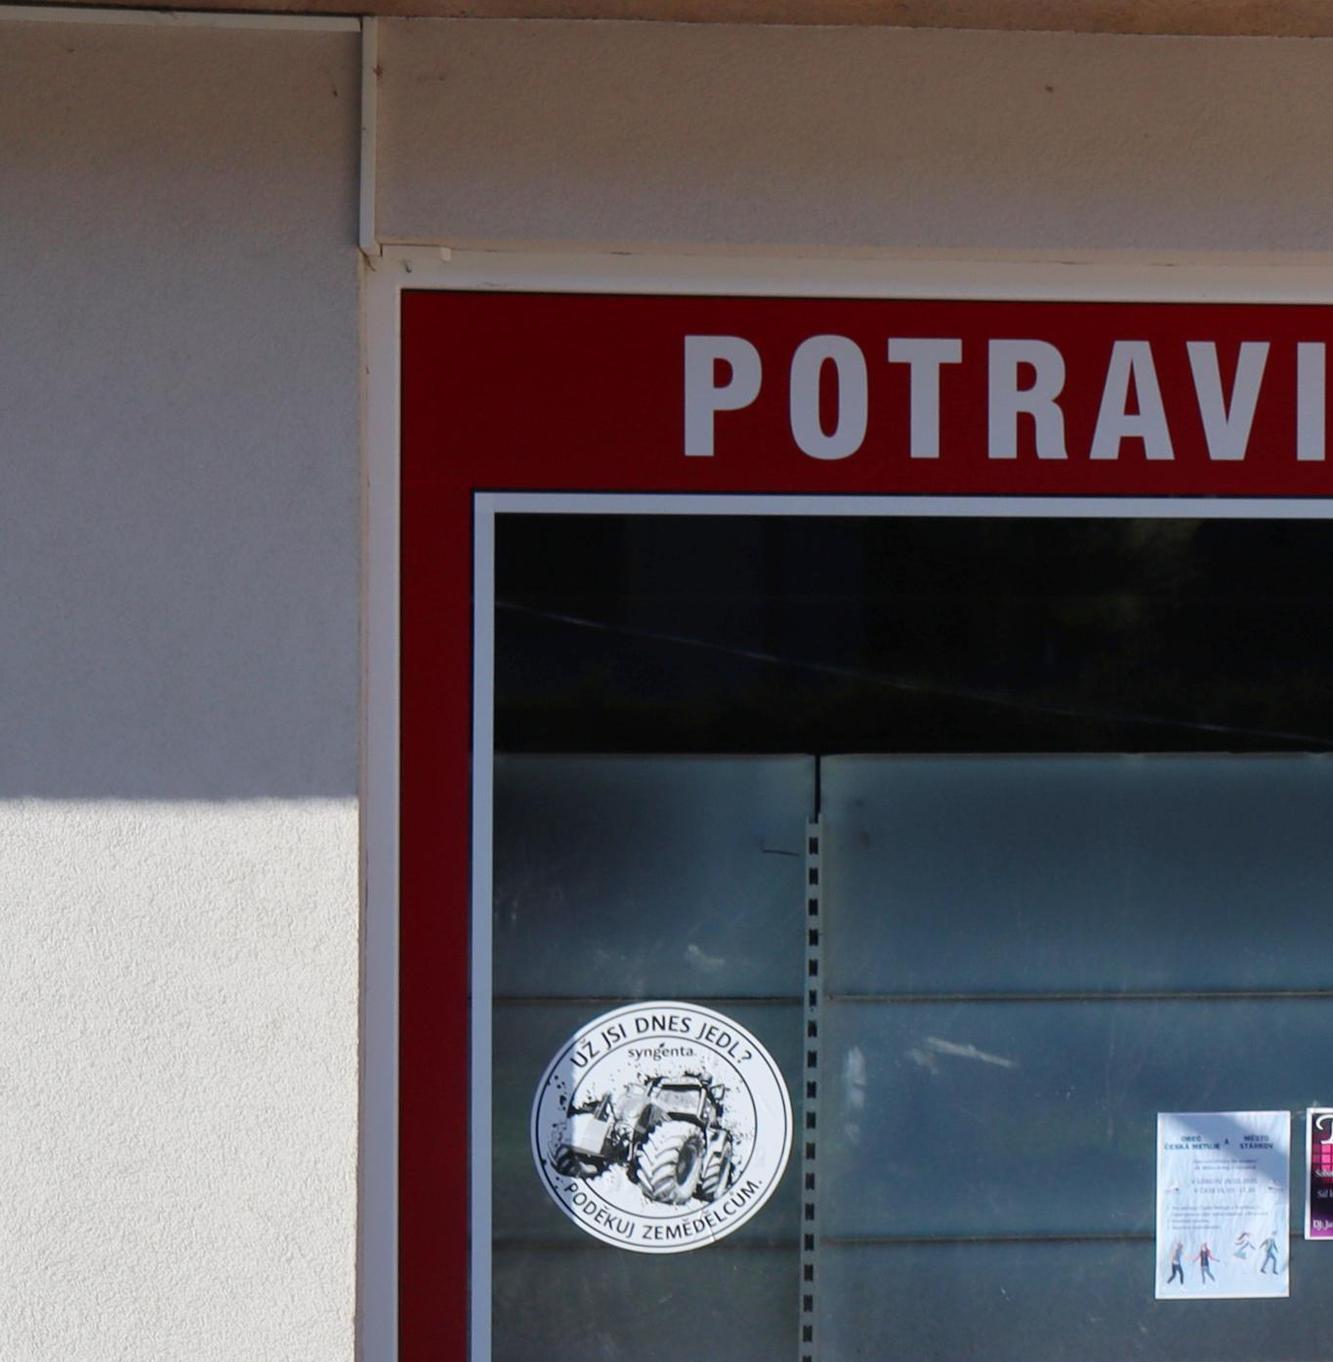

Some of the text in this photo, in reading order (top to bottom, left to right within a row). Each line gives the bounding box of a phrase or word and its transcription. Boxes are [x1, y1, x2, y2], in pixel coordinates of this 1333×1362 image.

[570, 1015, 752, 1069] UŽ JSI DNES JEDL?
[564, 1179, 763, 1241] PODĚKUJ ZEMĚDĚLCŮM.
